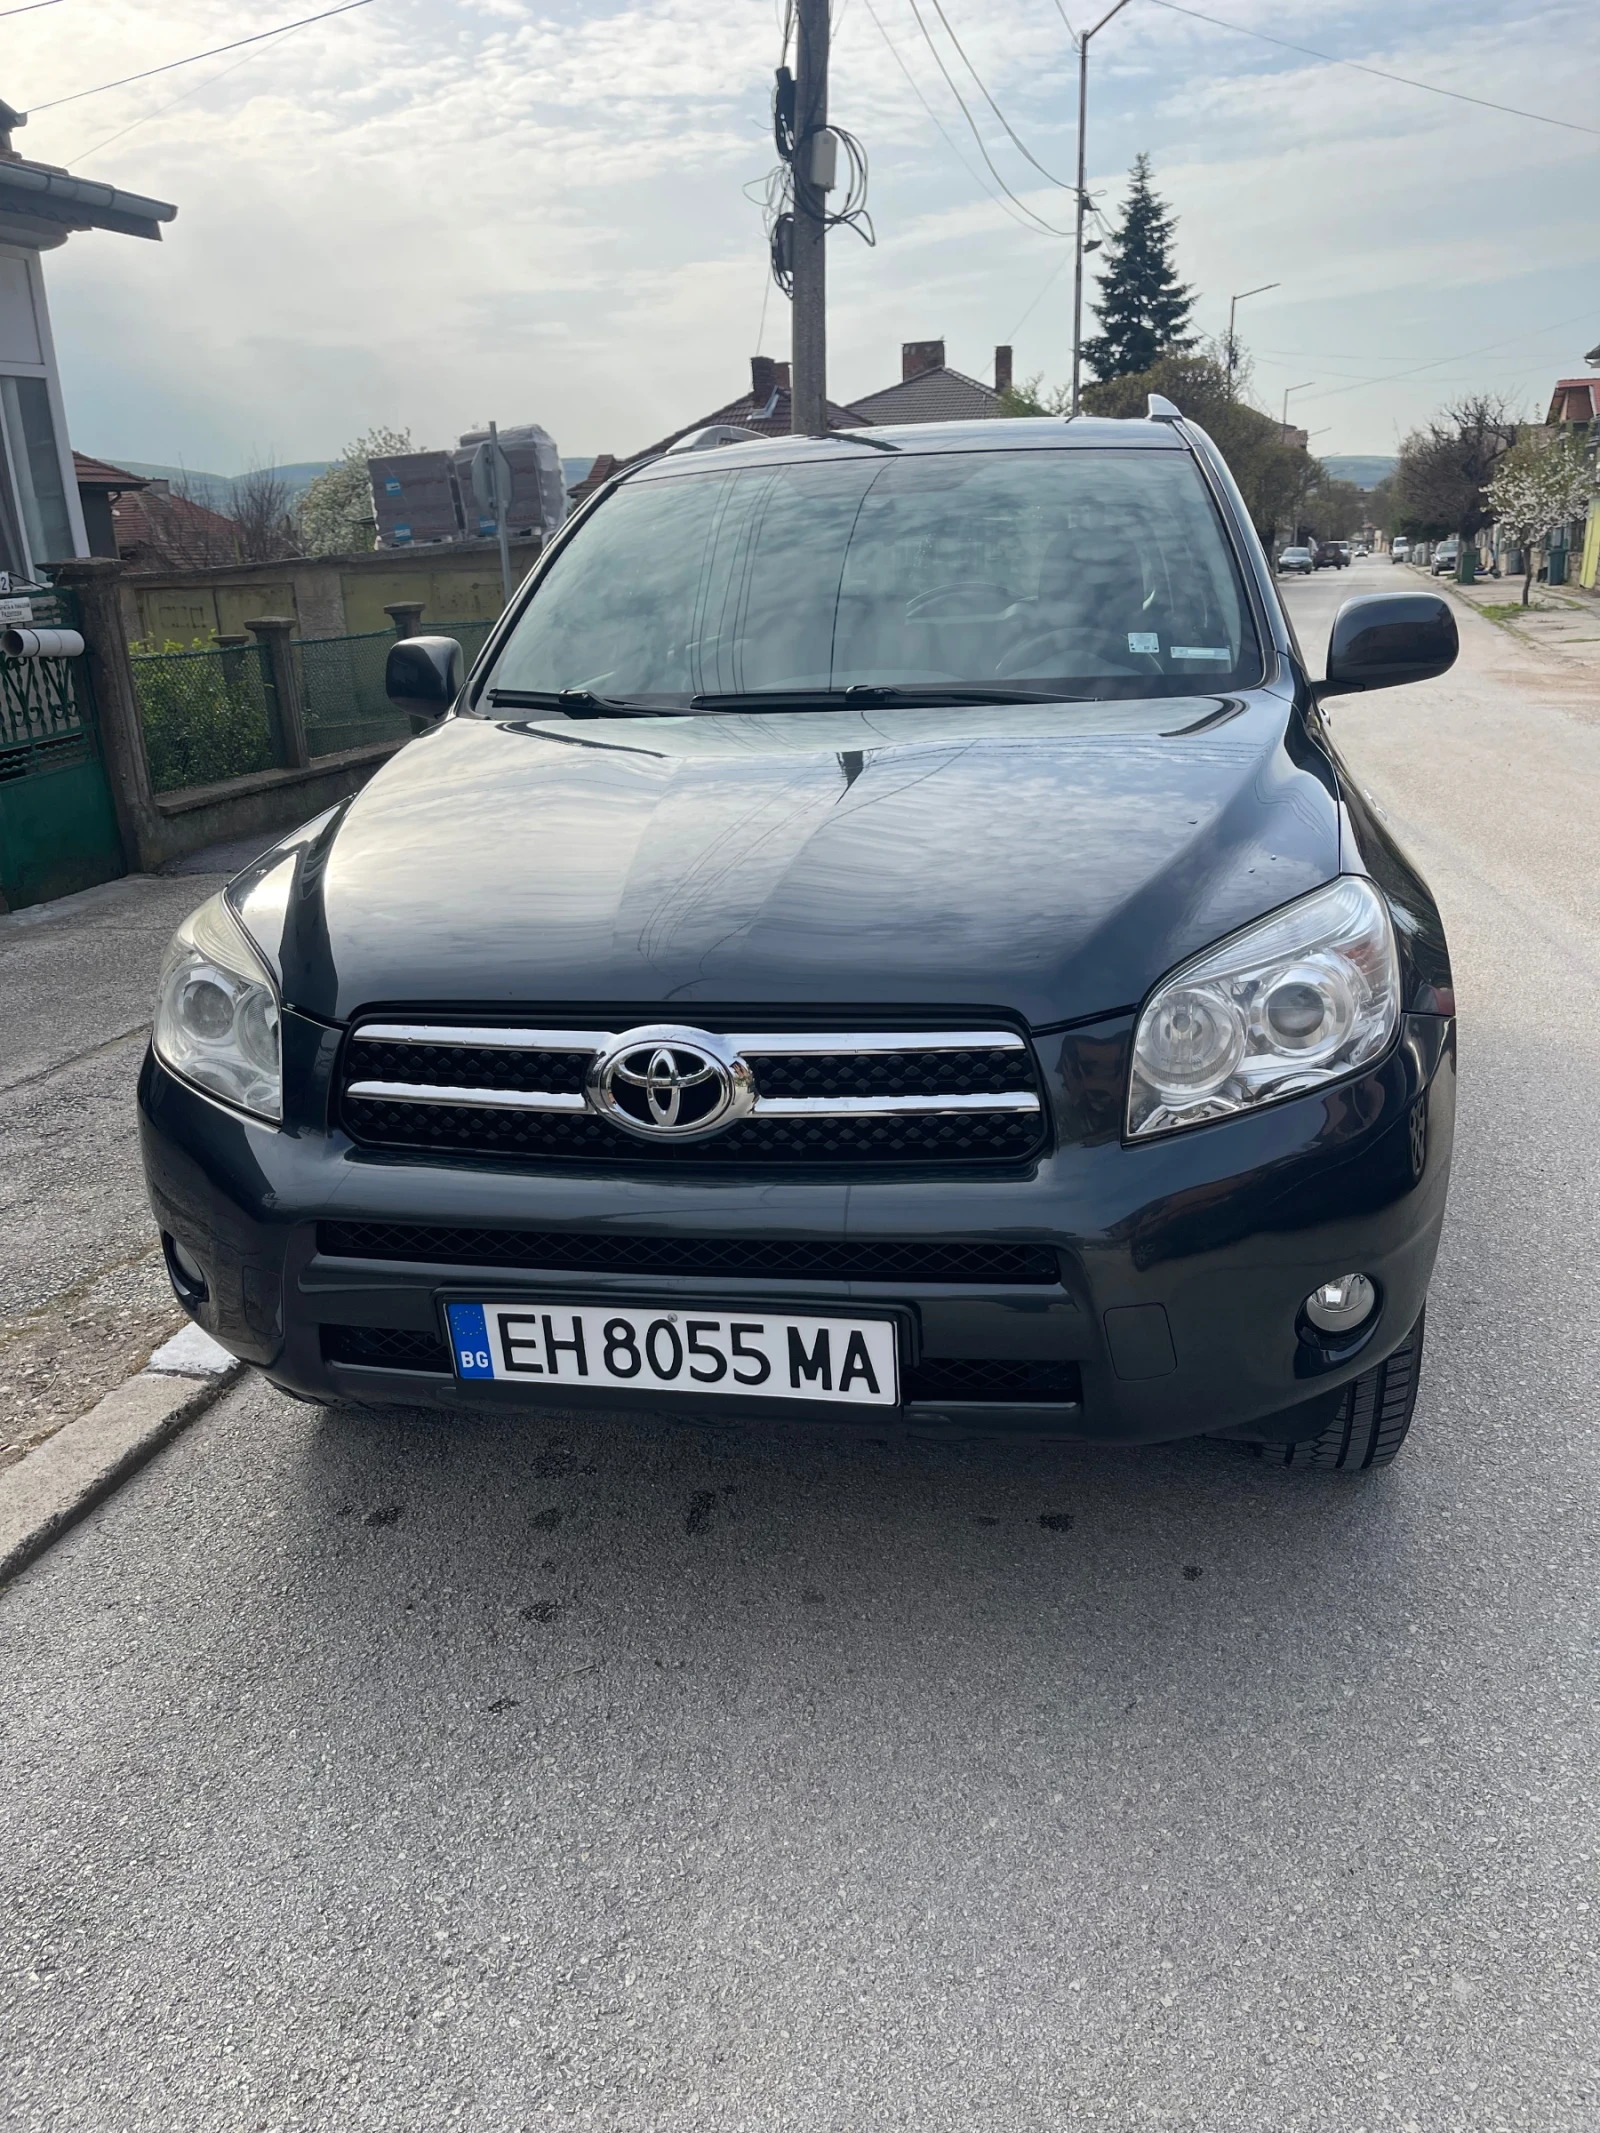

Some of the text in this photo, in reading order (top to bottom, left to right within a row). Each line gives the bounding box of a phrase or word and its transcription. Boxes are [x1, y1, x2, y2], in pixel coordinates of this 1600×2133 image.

[461, 1351, 489, 1369] BG
[498, 1313, 880, 1394] EH 8055 MA
